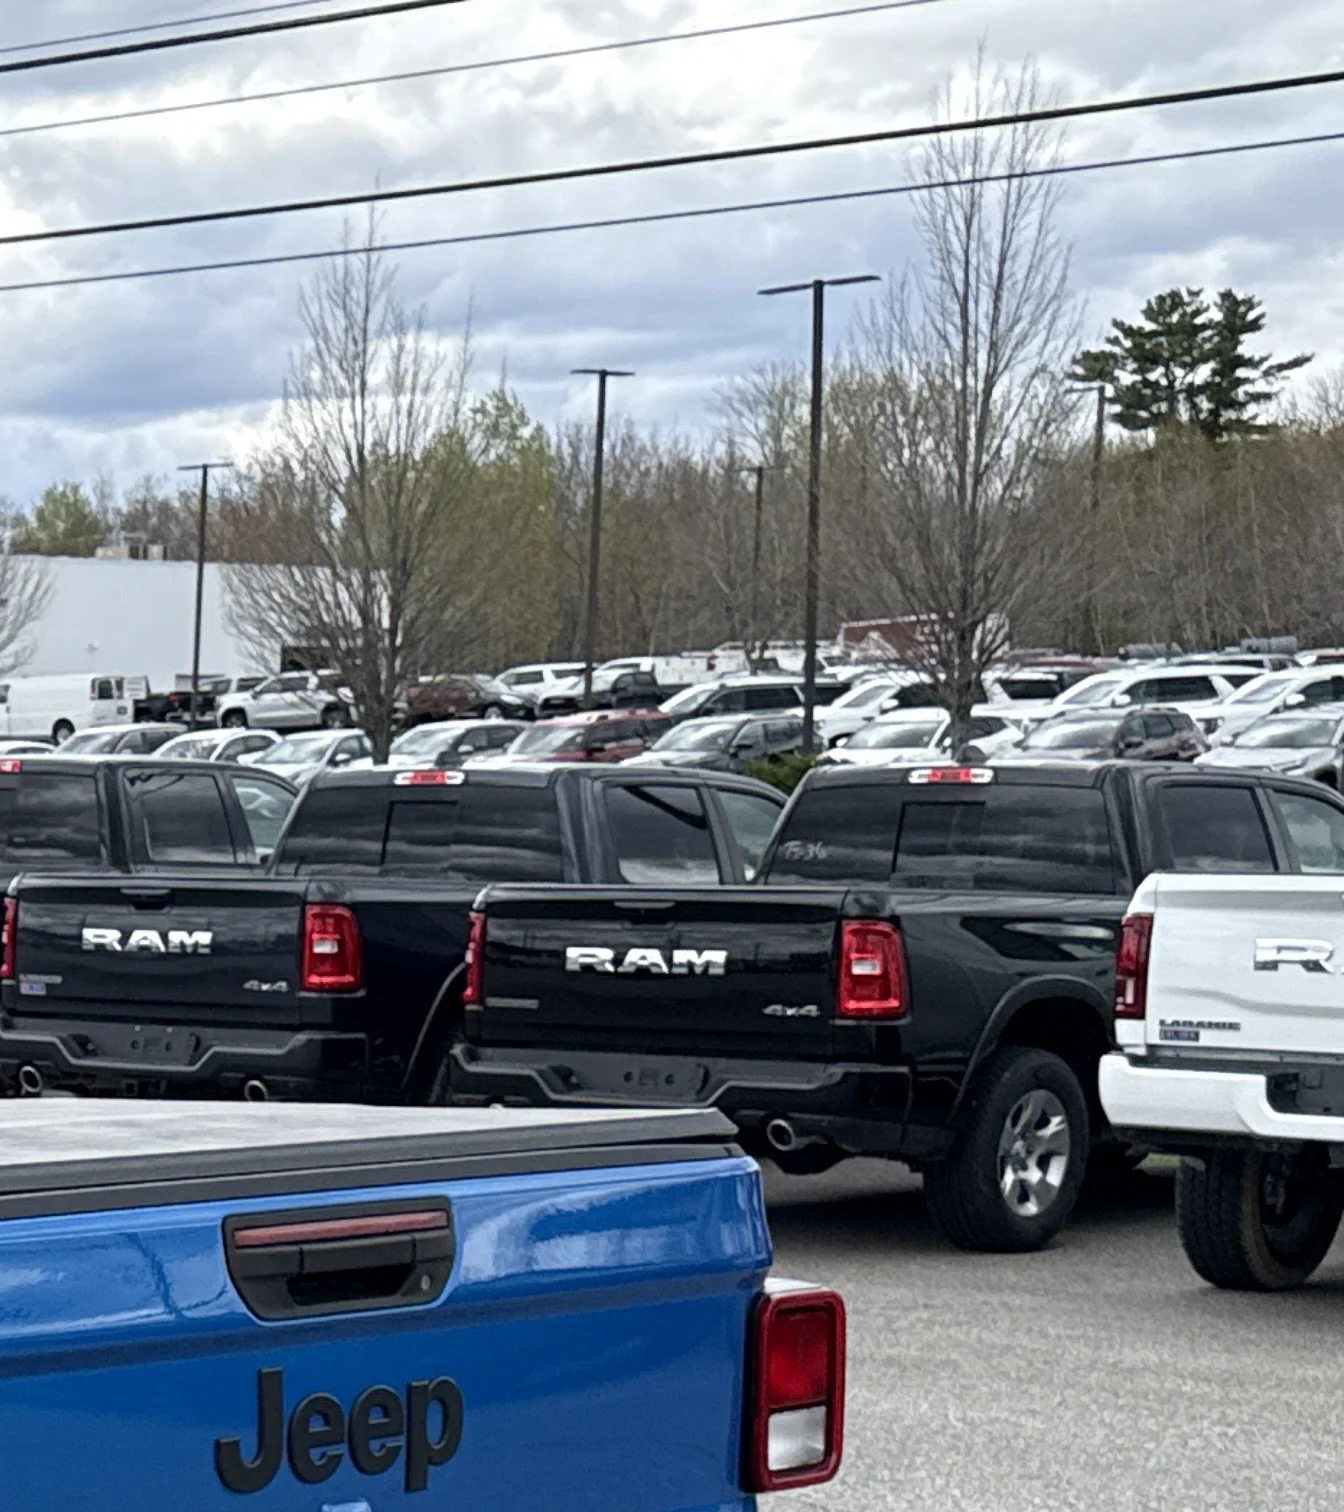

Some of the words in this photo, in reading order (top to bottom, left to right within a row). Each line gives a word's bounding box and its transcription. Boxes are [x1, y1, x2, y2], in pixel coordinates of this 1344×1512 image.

[81, 927, 213, 954] RAM
[564, 946, 728, 976] RAM
[1253, 938, 1344, 974] R
[243, 978, 290, 993] 4x4
[762, 1003, 821, 1018] 4x4
[214, 1365, 465, 1493] Jeep
